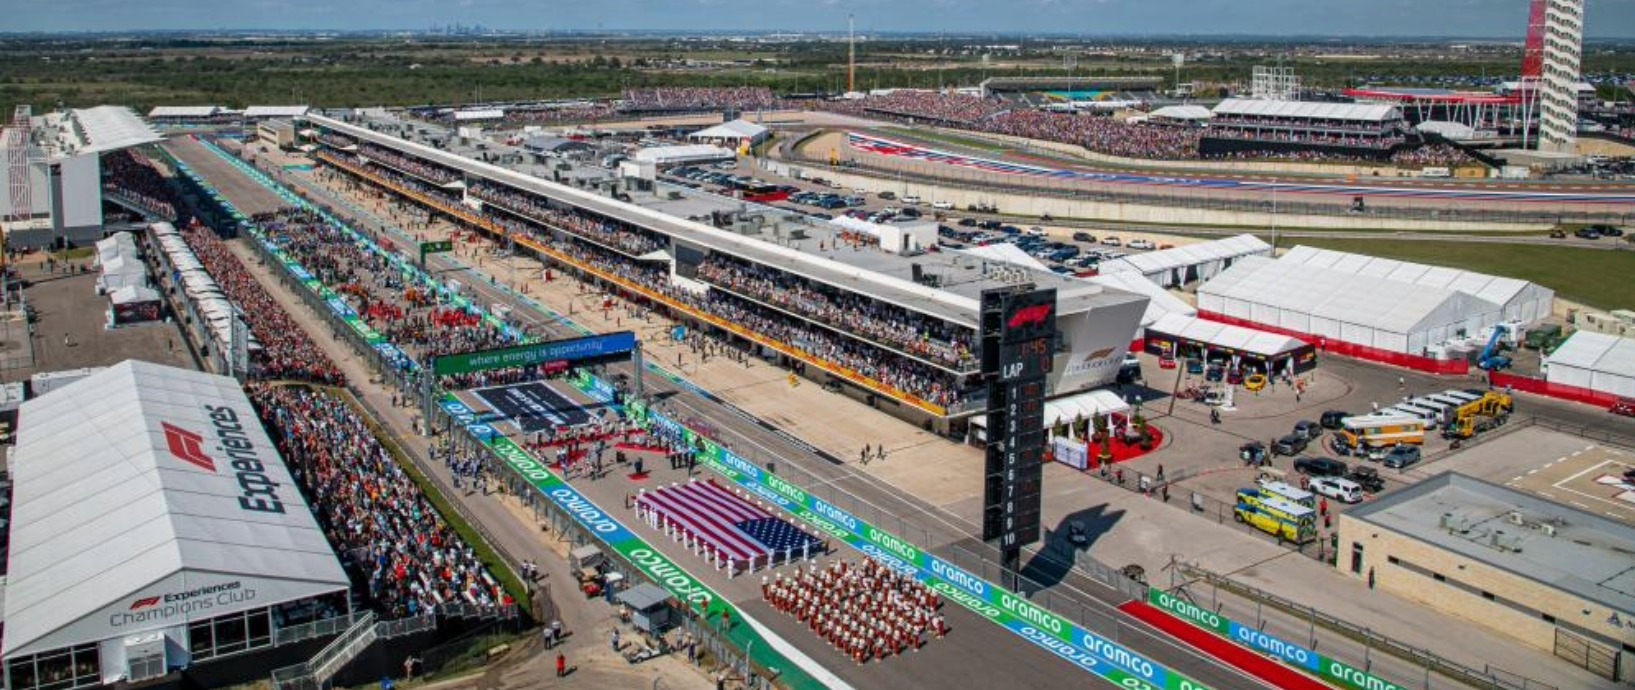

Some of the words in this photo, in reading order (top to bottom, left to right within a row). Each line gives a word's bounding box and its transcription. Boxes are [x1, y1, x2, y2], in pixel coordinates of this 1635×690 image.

[469, 355, 501, 366] where
[502, 349, 537, 361] energy
[539, 348, 547, 356] is
[550, 340, 603, 357] opportunity
[1003, 362, 1023, 378] LAP
[1012, 387, 1017, 399] 1
[1010, 403, 1017, 416] 2
[1009, 420, 1016, 432] 3
[1009, 436, 1016, 448] 4
[205, 404, 286, 514] Experiences
[1008, 452, 1015, 465] 5
[1008, 469, 1015, 480] 6
[768, 476, 805, 502] aramco
[1007, 485, 1013, 497] 7
[815, 501, 856, 529] aramco
[1007, 502, 1013, 513] 8
[1007, 517, 1013, 530] 9
[869, 528, 916, 560] aramco
[1004, 532, 1015, 546] 10
[931, 559, 984, 594] aramco
[163, 581, 241, 602] Experiences
[110, 598, 213, 627] Champions
[217, 588, 256, 605] Club
[1002, 594, 1062, 633] aramco
[1159, 594, 1220, 627] aramco
[1020, 626, 1097, 667] aramco
[1083, 635, 1153, 677] aramco
[1238, 627, 1307, 663] aramco
[1330, 662, 1404, 690] aram
